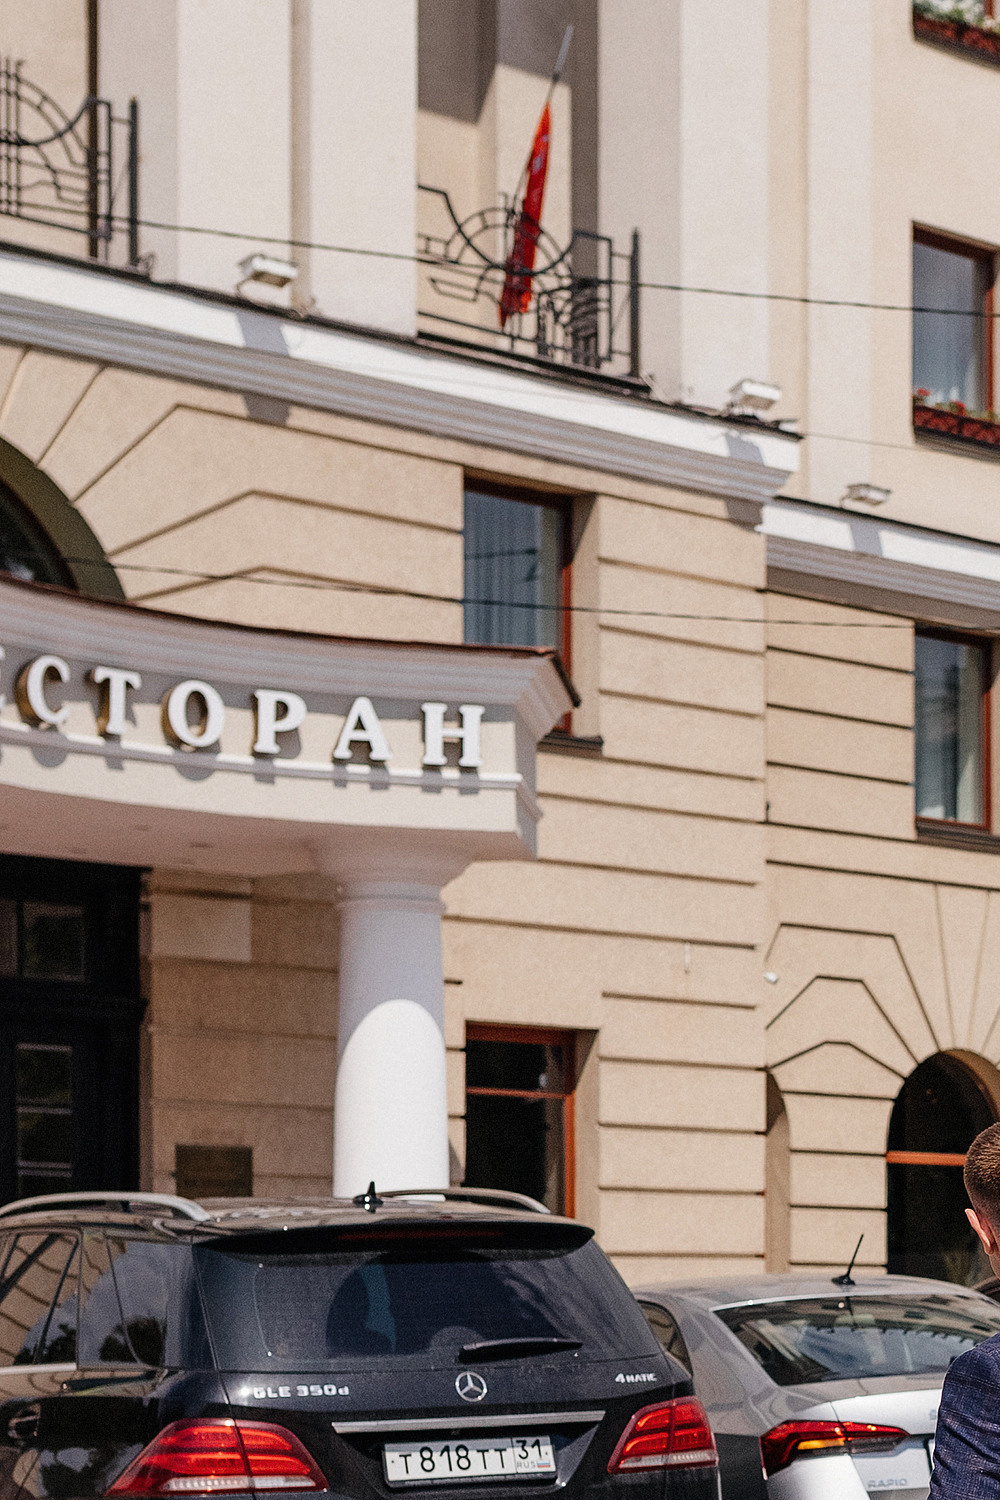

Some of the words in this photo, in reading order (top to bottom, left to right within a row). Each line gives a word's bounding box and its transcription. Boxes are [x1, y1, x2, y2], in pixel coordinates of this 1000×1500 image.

[0, 645, 485, 768] СТОРАН
[253, 1386, 291, 1399] GLE
[516, 1439, 542, 1459] 31
